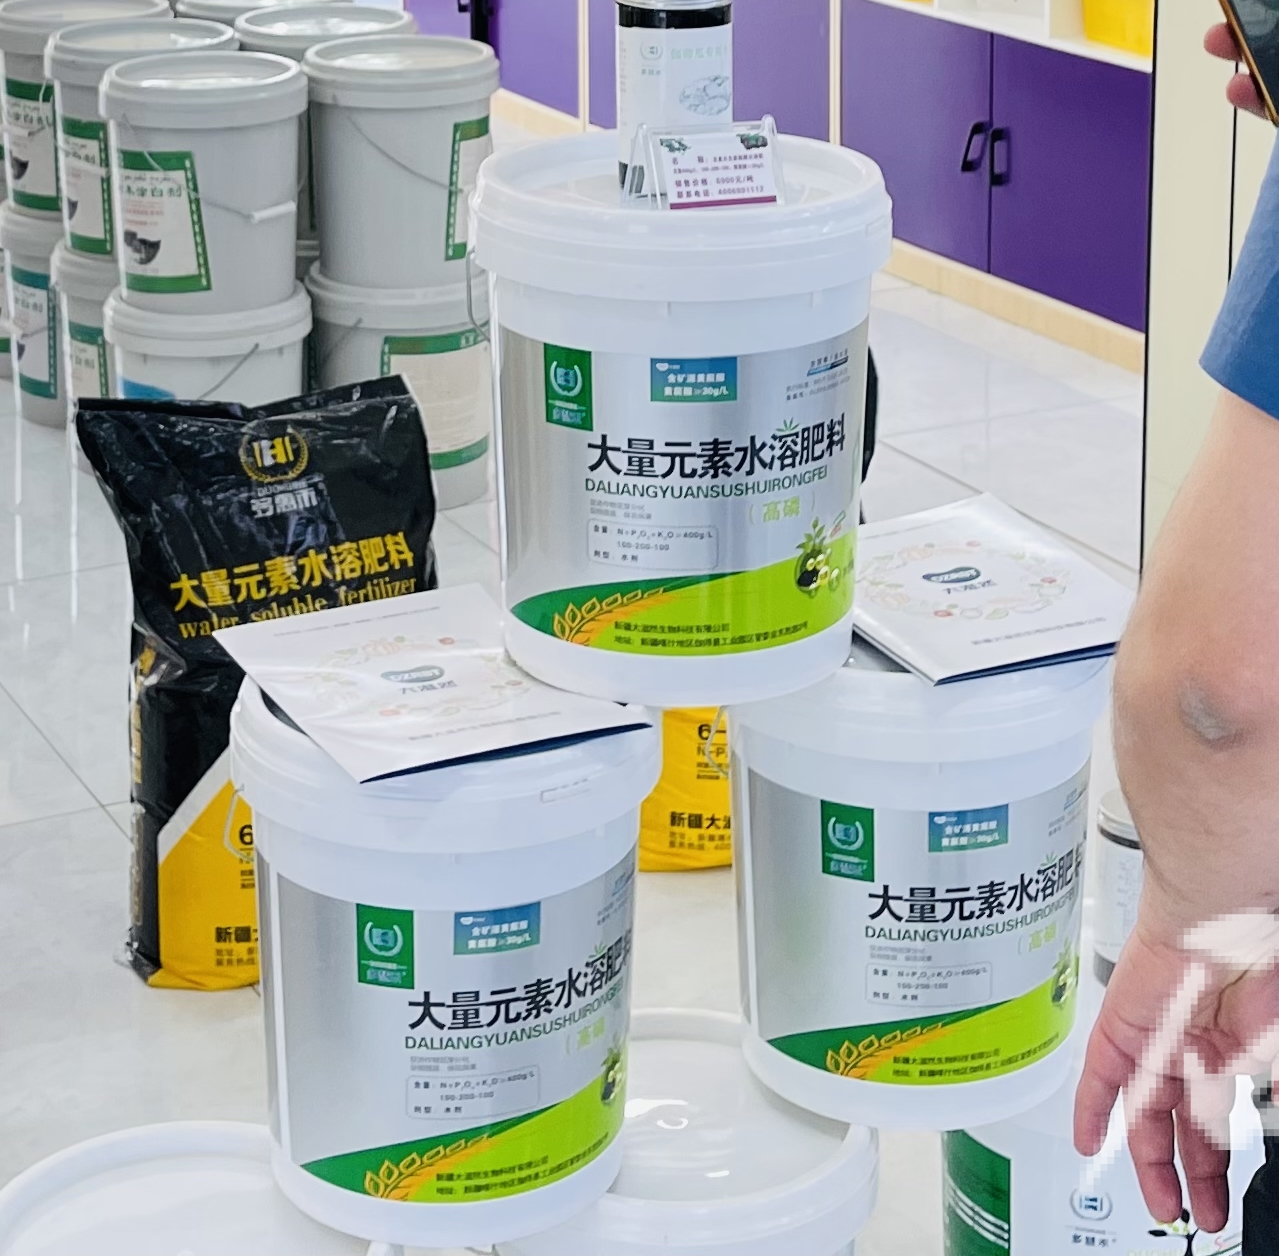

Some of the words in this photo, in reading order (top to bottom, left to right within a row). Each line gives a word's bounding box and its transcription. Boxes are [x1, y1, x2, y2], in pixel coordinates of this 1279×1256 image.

[587, 412, 846, 480] 大量元素水溶肥料
[585, 464, 828, 500] DALIANGYUANSUSHUIRONGFEI
[170, 530, 415, 612] 大量元素水溶肥料
[215, 925, 259, 944] 新疆
